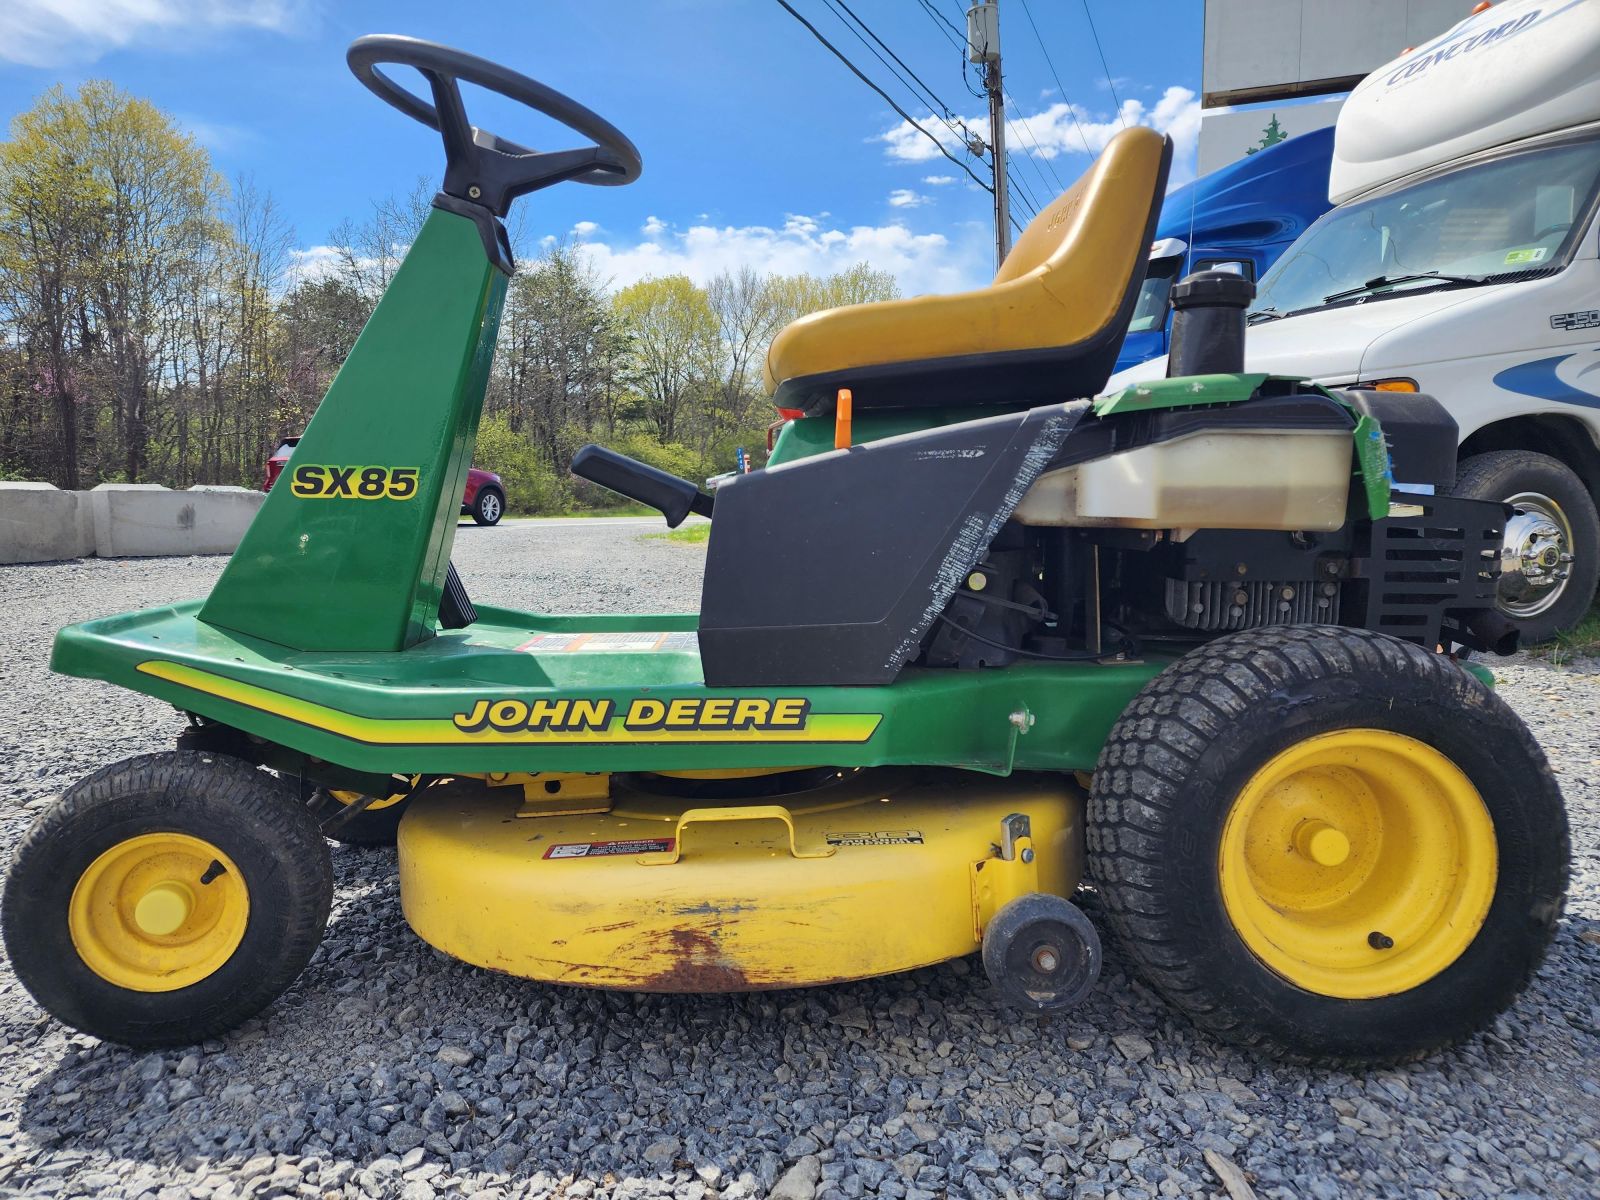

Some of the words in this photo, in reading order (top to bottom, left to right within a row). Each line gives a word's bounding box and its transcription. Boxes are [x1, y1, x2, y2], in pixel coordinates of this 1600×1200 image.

[1387, 9, 1541, 85] CONCORD
[1550, 310, 1600, 329] E450
[292, 465, 418, 498] SX85
[453, 699, 616, 732] JOHN
[623, 698, 811, 731] DEERE
